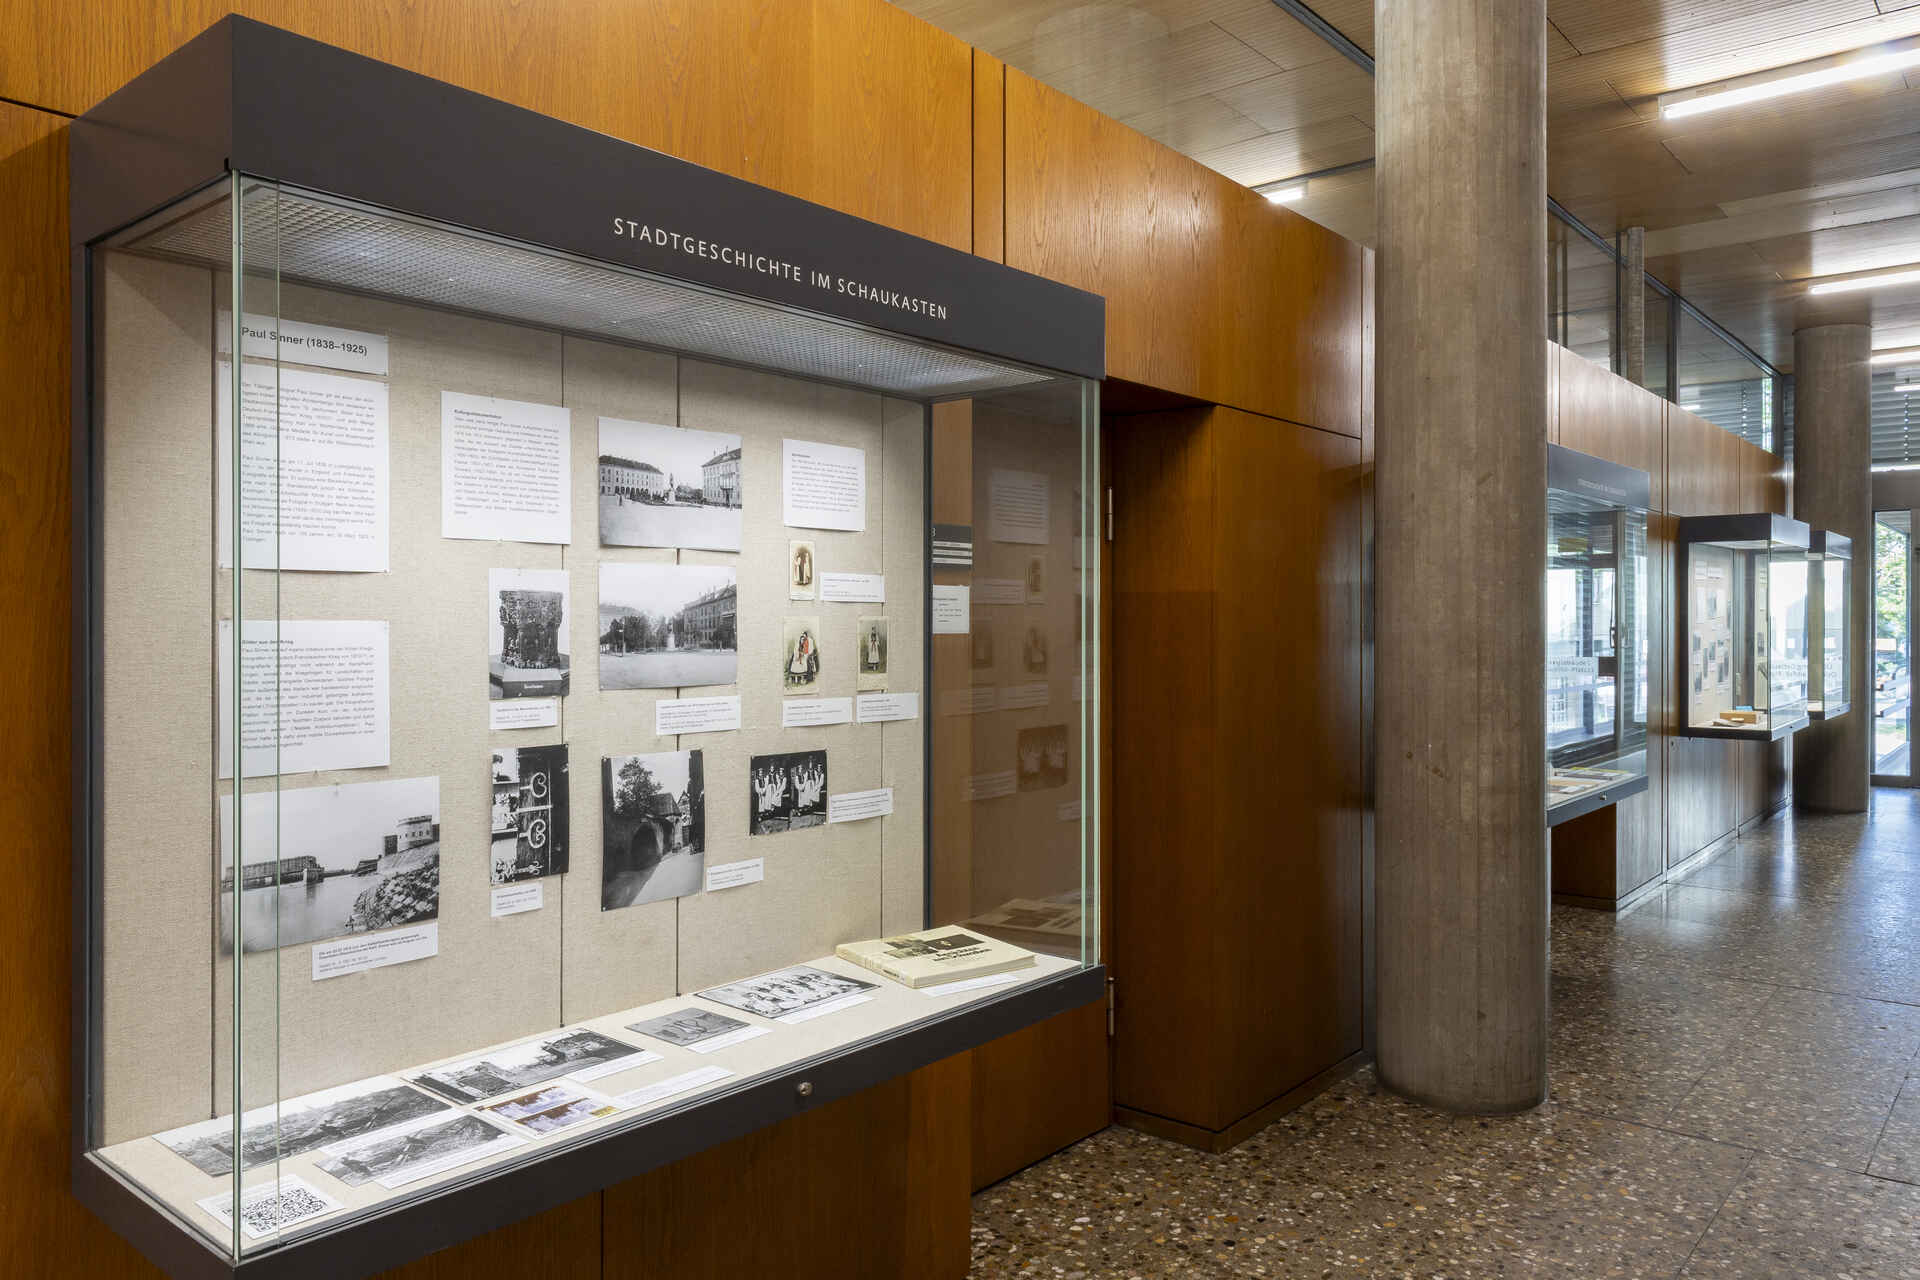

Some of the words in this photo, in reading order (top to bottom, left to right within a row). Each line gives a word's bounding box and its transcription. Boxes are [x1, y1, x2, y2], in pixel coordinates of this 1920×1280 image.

[613, 217, 802, 282] STADTGESCHICHTE
[811, 271, 831, 290] IM
[838, 279, 947, 320] SCHAUKASTEN
[241, 327, 266, 339] Paul
[269, 332, 304, 345] Snner
